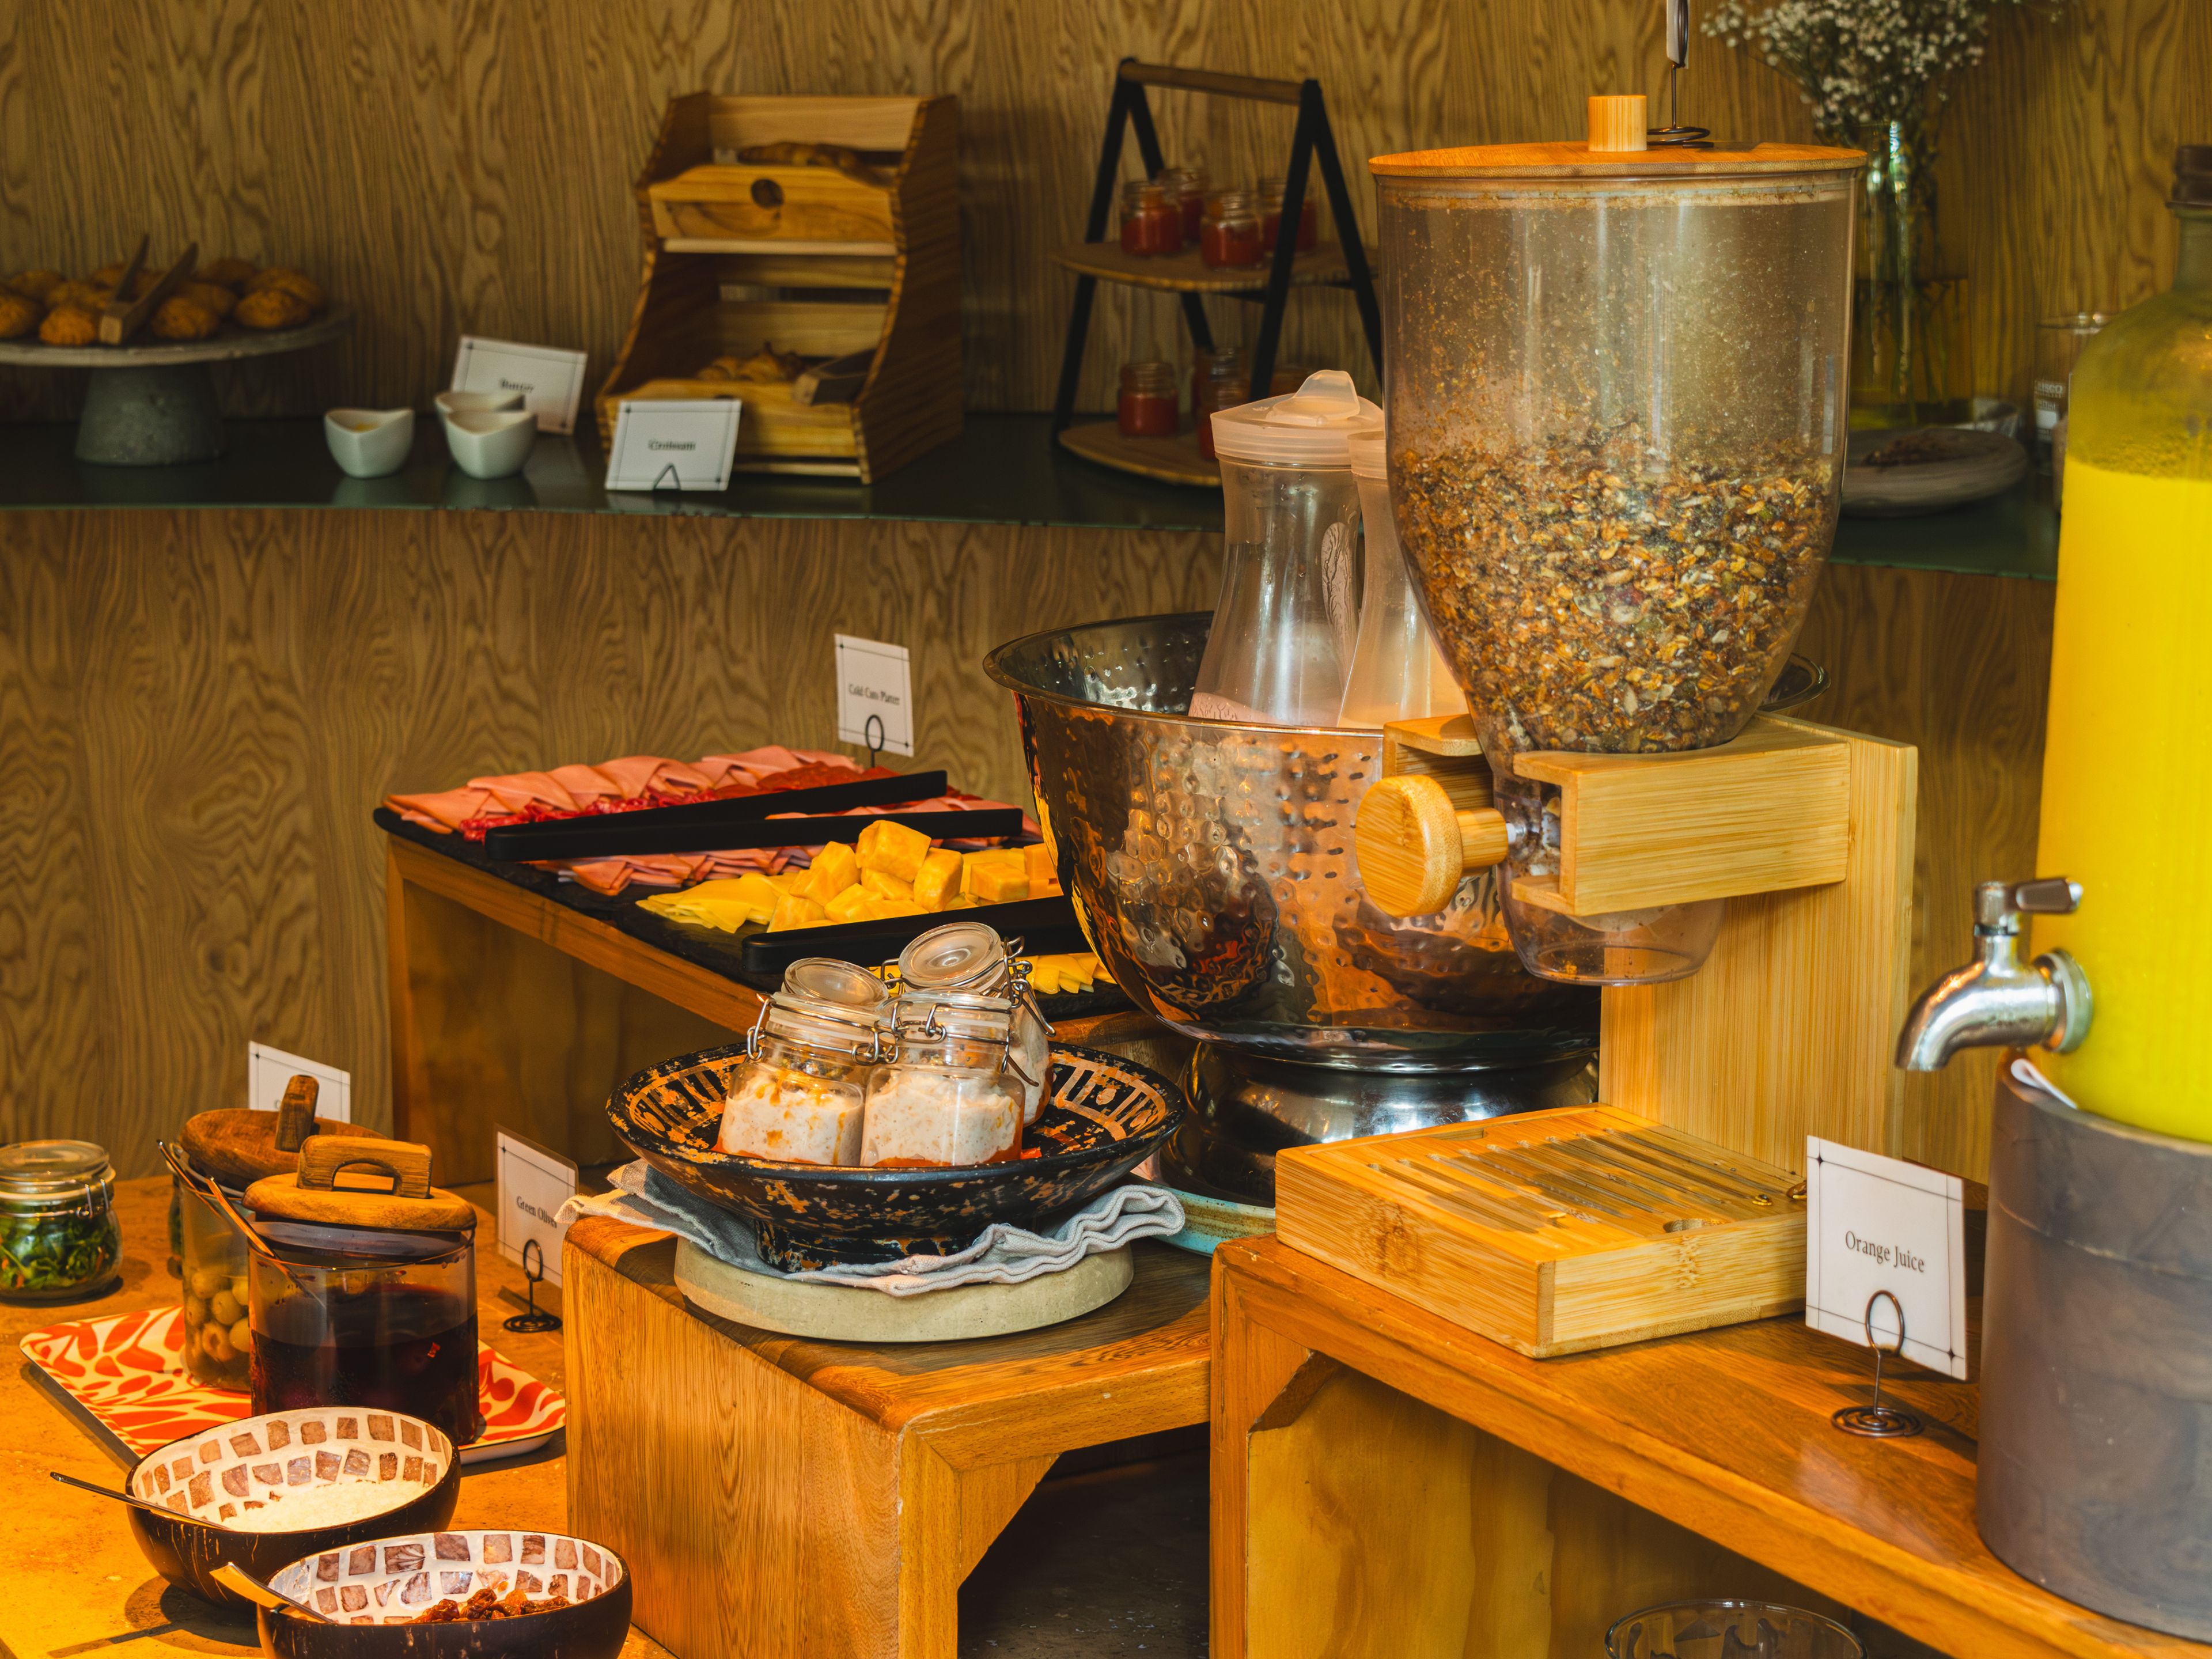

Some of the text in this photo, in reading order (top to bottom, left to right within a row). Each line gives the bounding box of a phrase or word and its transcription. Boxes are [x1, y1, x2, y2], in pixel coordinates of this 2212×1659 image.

[516, 1195, 536, 1217] Green
[1845, 1230, 1925, 1273] Orange Juice
